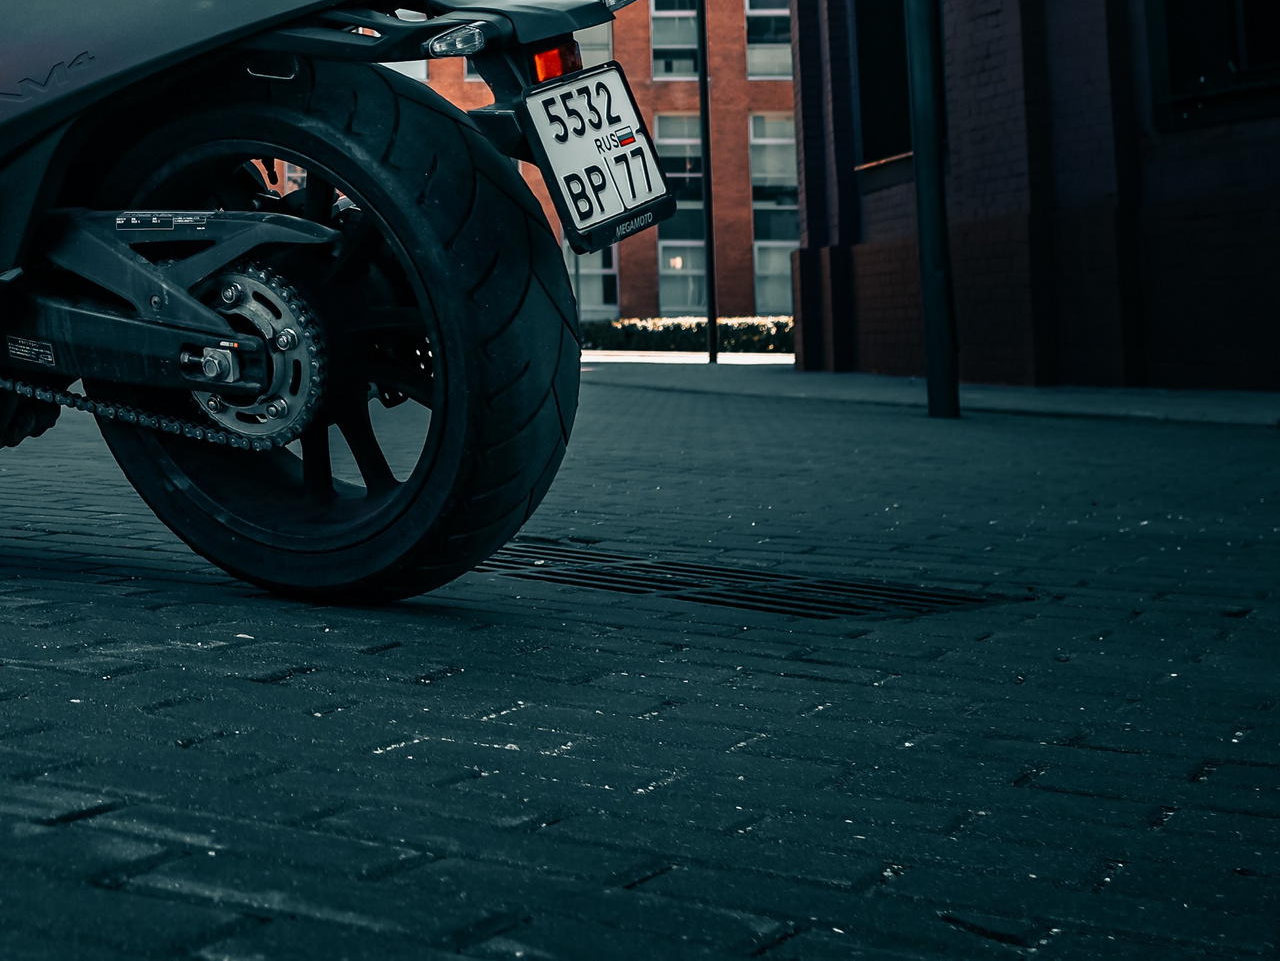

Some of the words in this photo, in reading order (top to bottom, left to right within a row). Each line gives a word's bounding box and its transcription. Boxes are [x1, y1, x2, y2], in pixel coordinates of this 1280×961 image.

[541, 81, 622, 143] 5532
[594, 133, 619, 154] RUS
[613, 146, 652, 200] 77
[616, 212, 653, 237] MEGAMOTO
